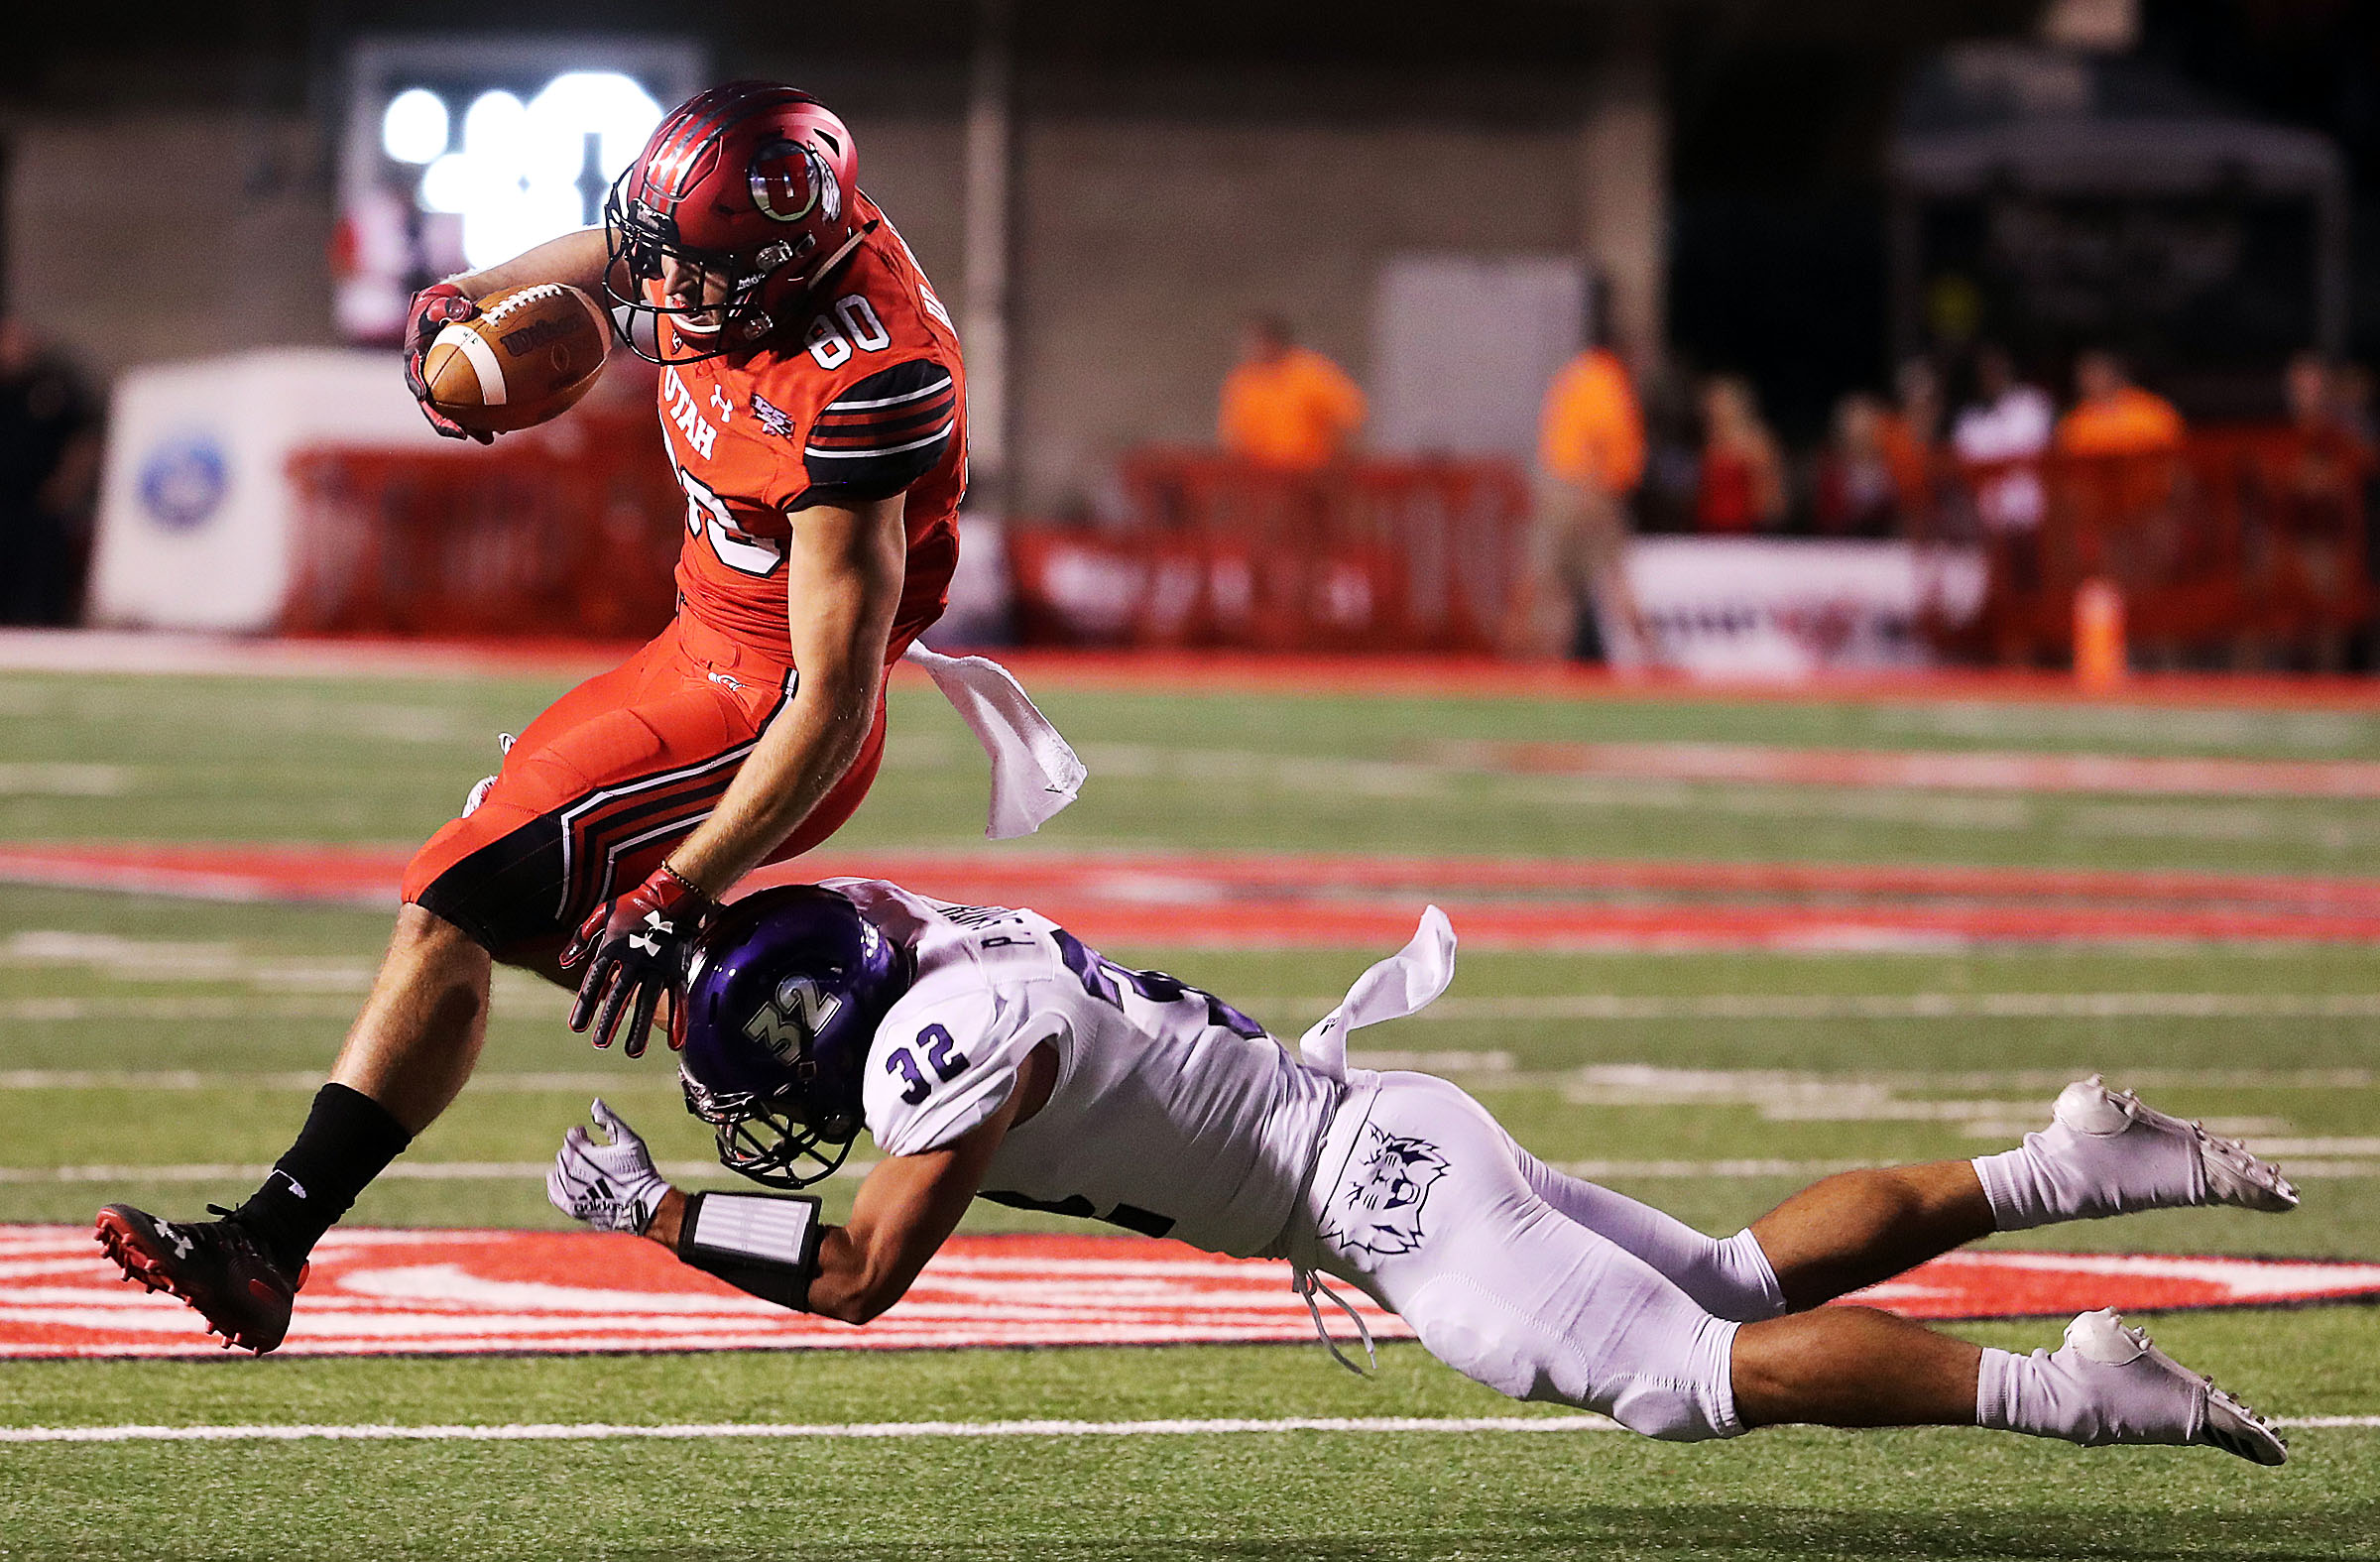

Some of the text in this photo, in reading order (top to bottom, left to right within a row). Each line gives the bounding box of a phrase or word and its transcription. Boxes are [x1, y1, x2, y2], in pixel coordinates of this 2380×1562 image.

[805, 295, 891, 371] 80
[663, 364, 719, 461] UTAH
[742, 973, 844, 1067] 32
[885, 1022, 970, 1107] 32
